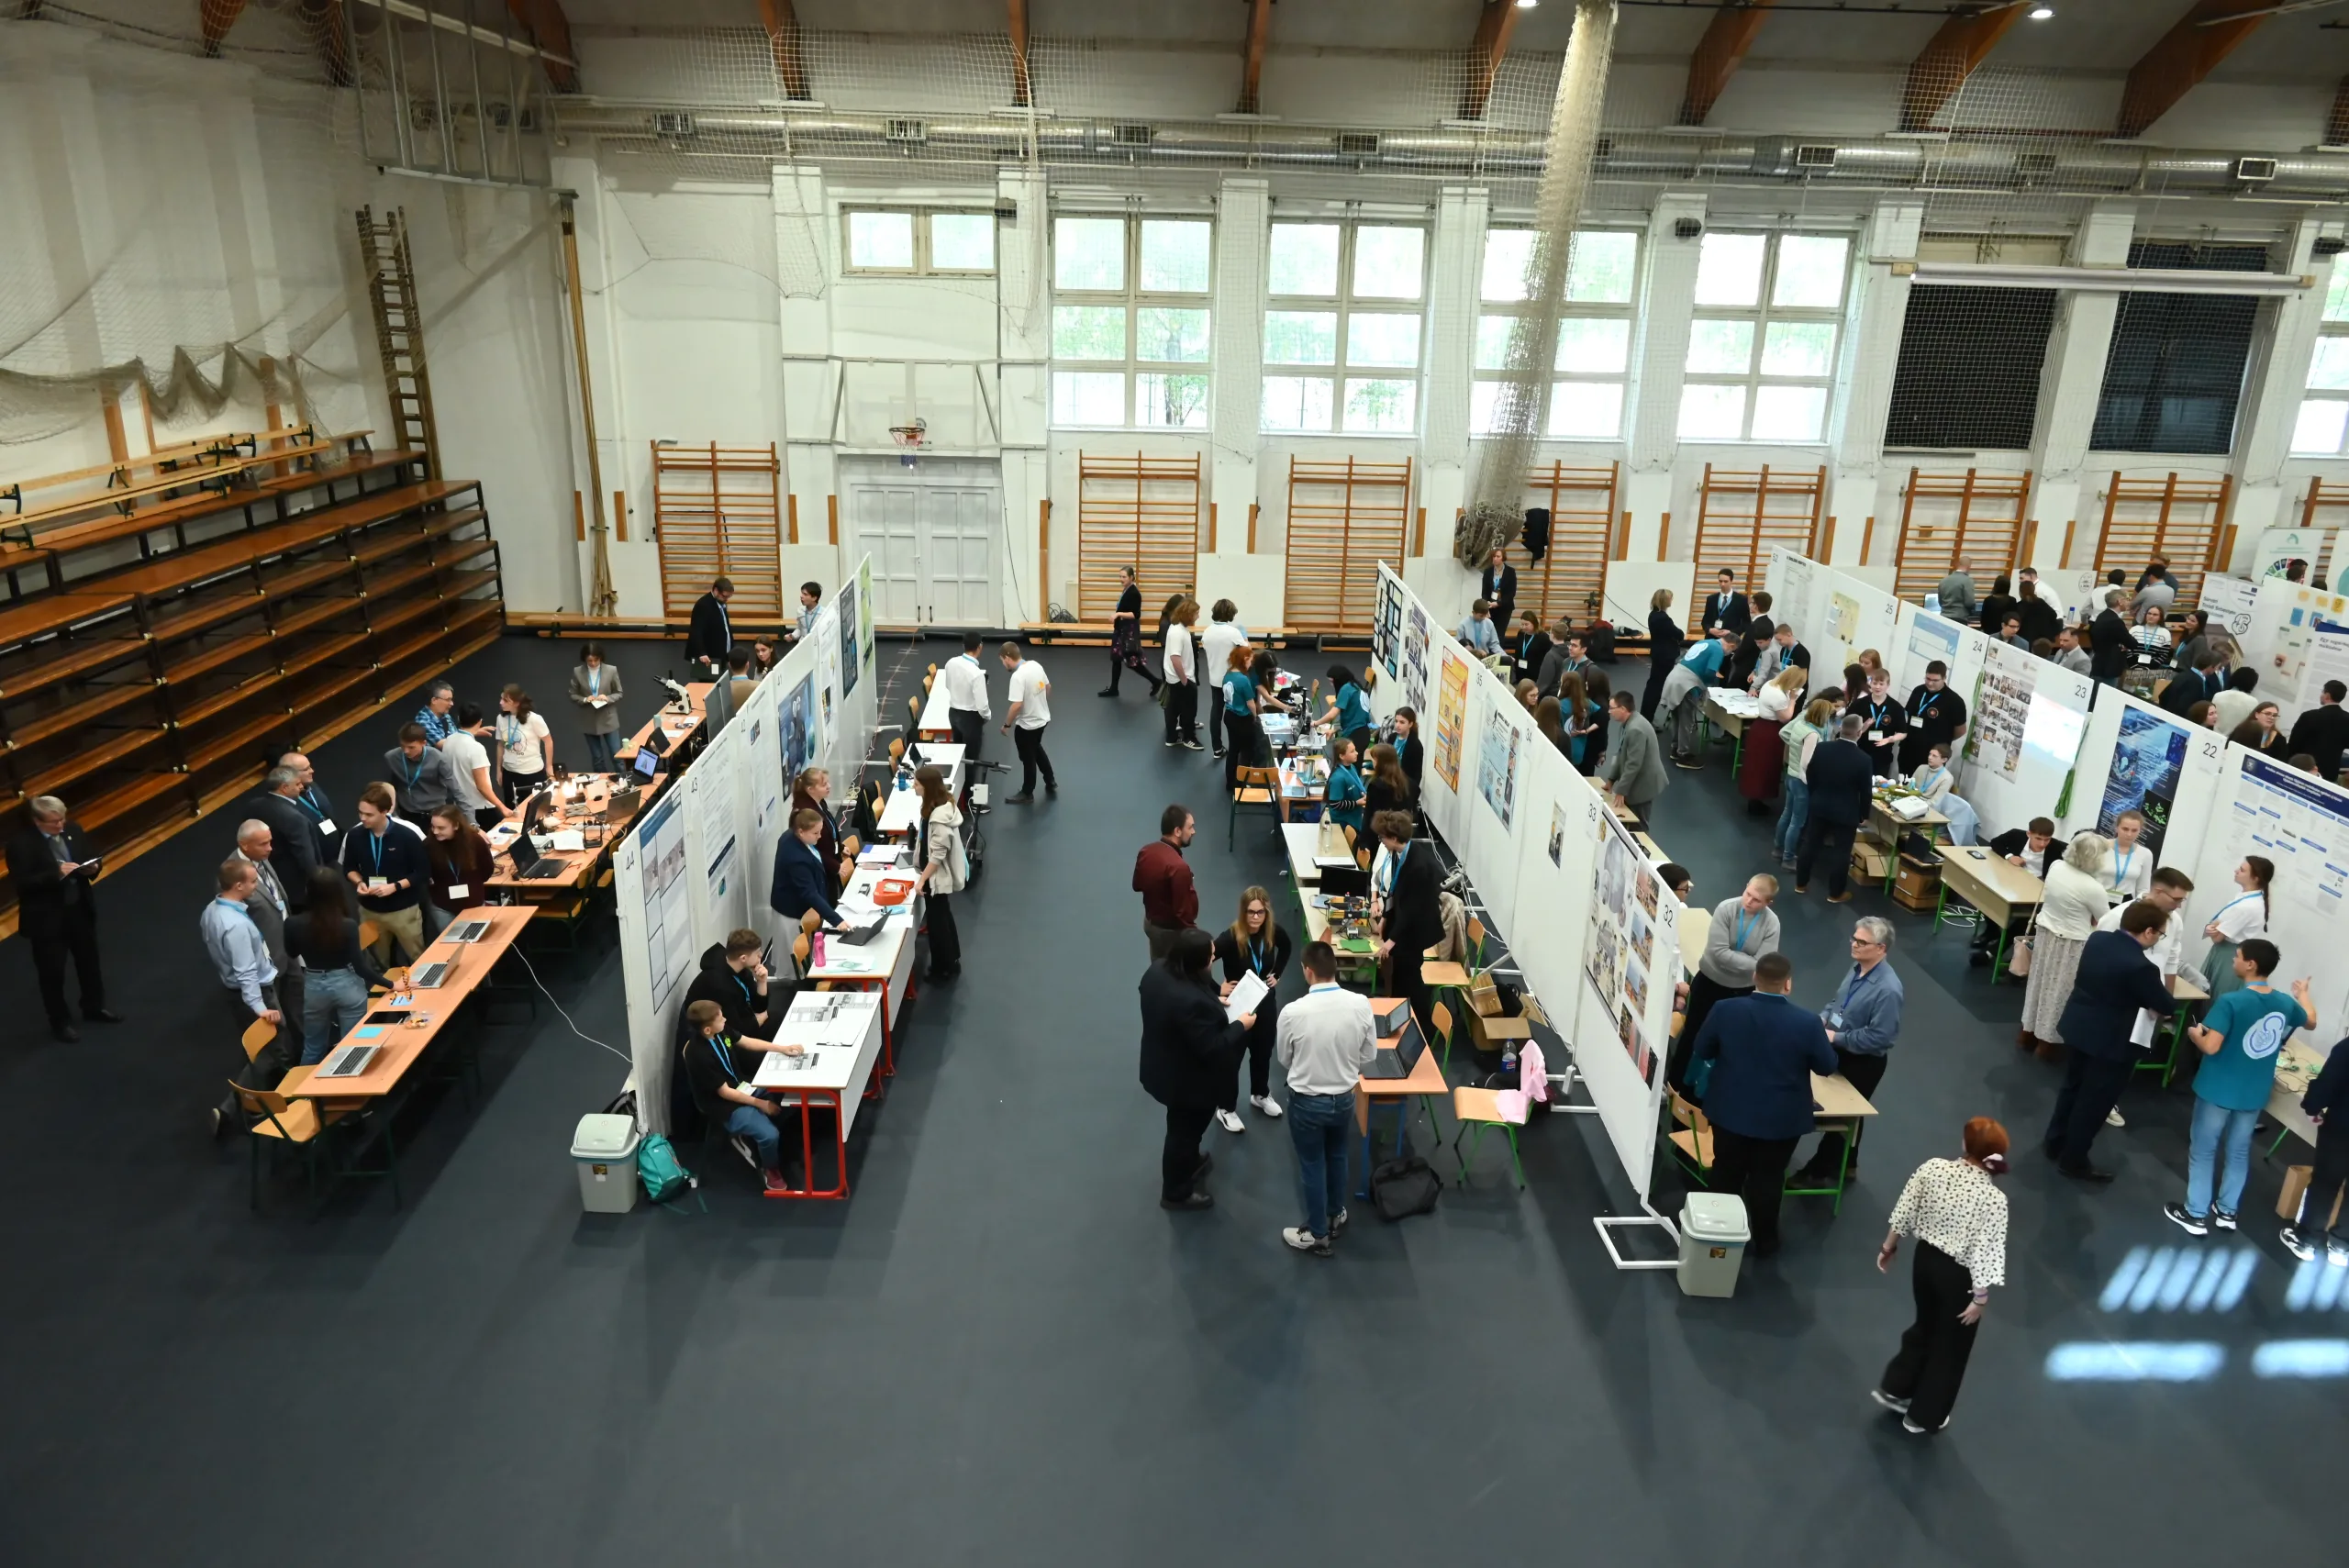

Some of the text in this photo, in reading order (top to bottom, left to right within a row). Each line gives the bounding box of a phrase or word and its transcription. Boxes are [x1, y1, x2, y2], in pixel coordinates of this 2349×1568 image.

[1885, 603, 1894, 615] 25
[1973, 640, 1983, 652] 24
[1475, 673, 1483, 687] 35
[2075, 684, 2087, 699] 23
[1525, 728, 1532, 744] 34
[2202, 742, 2218, 759] 22
[691, 776, 698, 794] 43
[1588, 803, 1597, 822] 33
[626, 851, 635, 872] 44
[1663, 904, 1674, 929] 32
